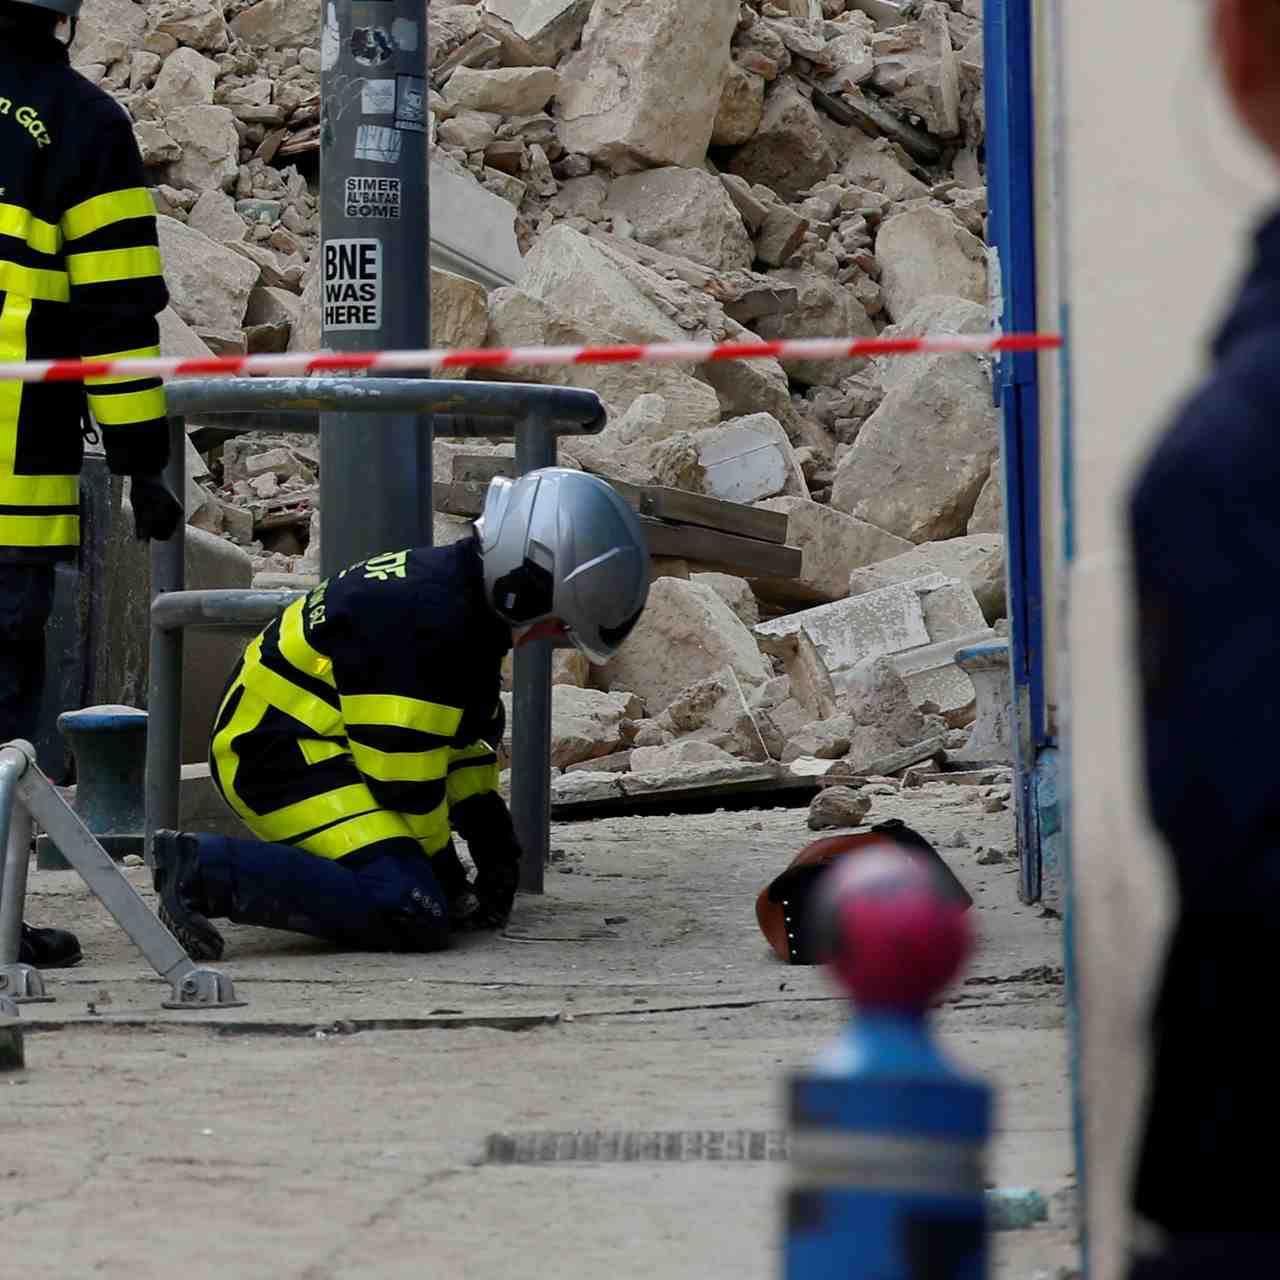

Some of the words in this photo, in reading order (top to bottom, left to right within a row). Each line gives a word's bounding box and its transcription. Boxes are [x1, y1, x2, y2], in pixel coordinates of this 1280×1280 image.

[15, 106, 52, 149] Gaz
[346, 178, 400, 192] SIMER
[325, 243, 377, 281] BNE
[325, 283, 377, 303] WAS
[325, 305, 377, 325] HERE
